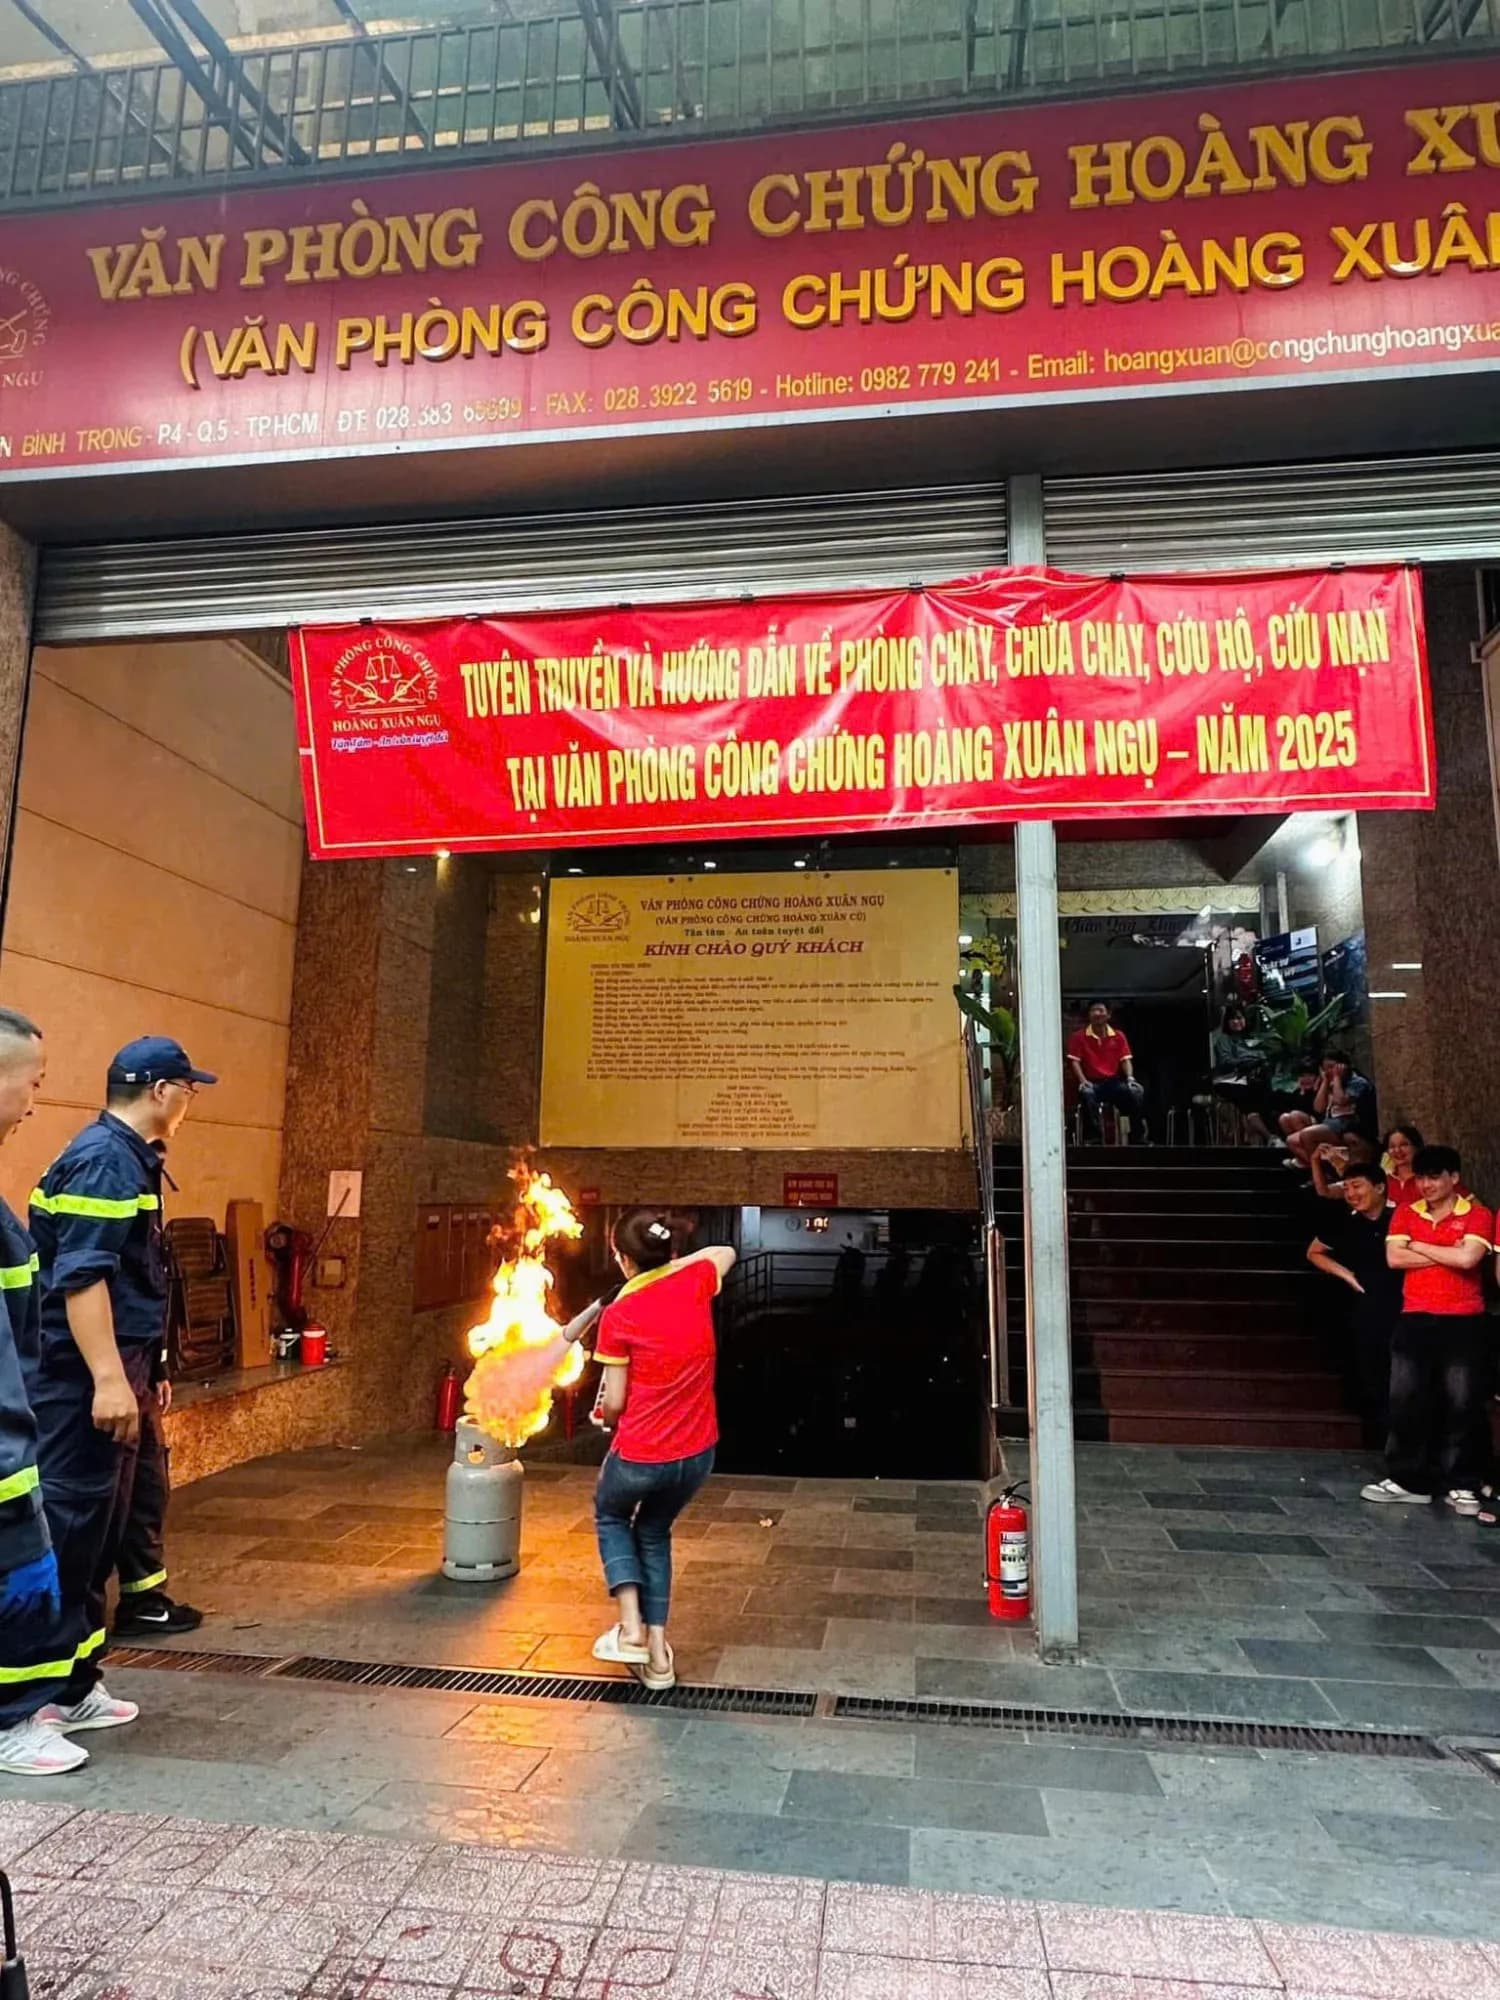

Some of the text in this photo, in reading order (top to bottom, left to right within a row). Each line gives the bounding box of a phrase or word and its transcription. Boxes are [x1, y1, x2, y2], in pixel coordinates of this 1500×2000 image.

[88, 226, 222, 300] VĂN
[242, 199, 483, 287] PHÒNG
[509, 182, 715, 261] CÔNG
[748, 142, 1039, 238] CHỨNG
[1068, 112, 1373, 209] HOÀNG
[180, 202, 1500, 388] (VĂN PHÒNG CÔNG CHỨNG HOÀNG XUÂ
[22, 429, 66, 457] BÌNH
[77, 426, 143, 455] TRỌNG
[198, 419, 229, 443] Q.5
[546, 391, 593, 416] FAX:
[604, 381, 697, 412] 028.3922
[708, 377, 752, 403] 5619
[776, 372, 854, 399] Hotline:
[860, 366, 911, 393] 0982
[918, 361, 957, 388] 779
[964, 357, 1001, 385] 241
[1028, 352, 1095, 380] Email:
[376, 634, 413, 655] CÔNG
[460, 601, 1390, 718] TUYÊN TRUYỀN VÀ HƯỚNG DẪN VỀ PHÒNG CHÁY, CHỮA CHÁY, CỨU HỘ, CỨU NẠN
[332, 718, 378, 733] HOÀNG
[381, 713, 415, 729] XUÂN
[507, 755, 546, 822] TẠI
[553, 738, 602, 809] VĂN
[609, 734, 695, 803] PHÒNG
[704, 732, 780, 796] CÔNG
[788, 722, 885, 794] CHỨNG
[893, 709, 994, 788] HOÀNG
[1003, 707, 1086, 779] XUÂN
[1095, 717, 1160, 794] NGỤ
[1197, 704, 1269, 775] NĂM
[1278, 710, 1358, 772] 2025
[643, 939, 691, 957] KÍNH
[694, 938, 747, 956] CHÀO
[750, 938, 793, 958] QUÝ
[795, 937, 865, 955] KHÁCH
[666, 898, 704, 911] PHÒNG
[707, 896, 737, 910] CÔNG
[741, 894, 780, 909] CHỨNG
[784, 894, 823, 908] HOÀNG
[826, 892, 858, 907] XUÂN
